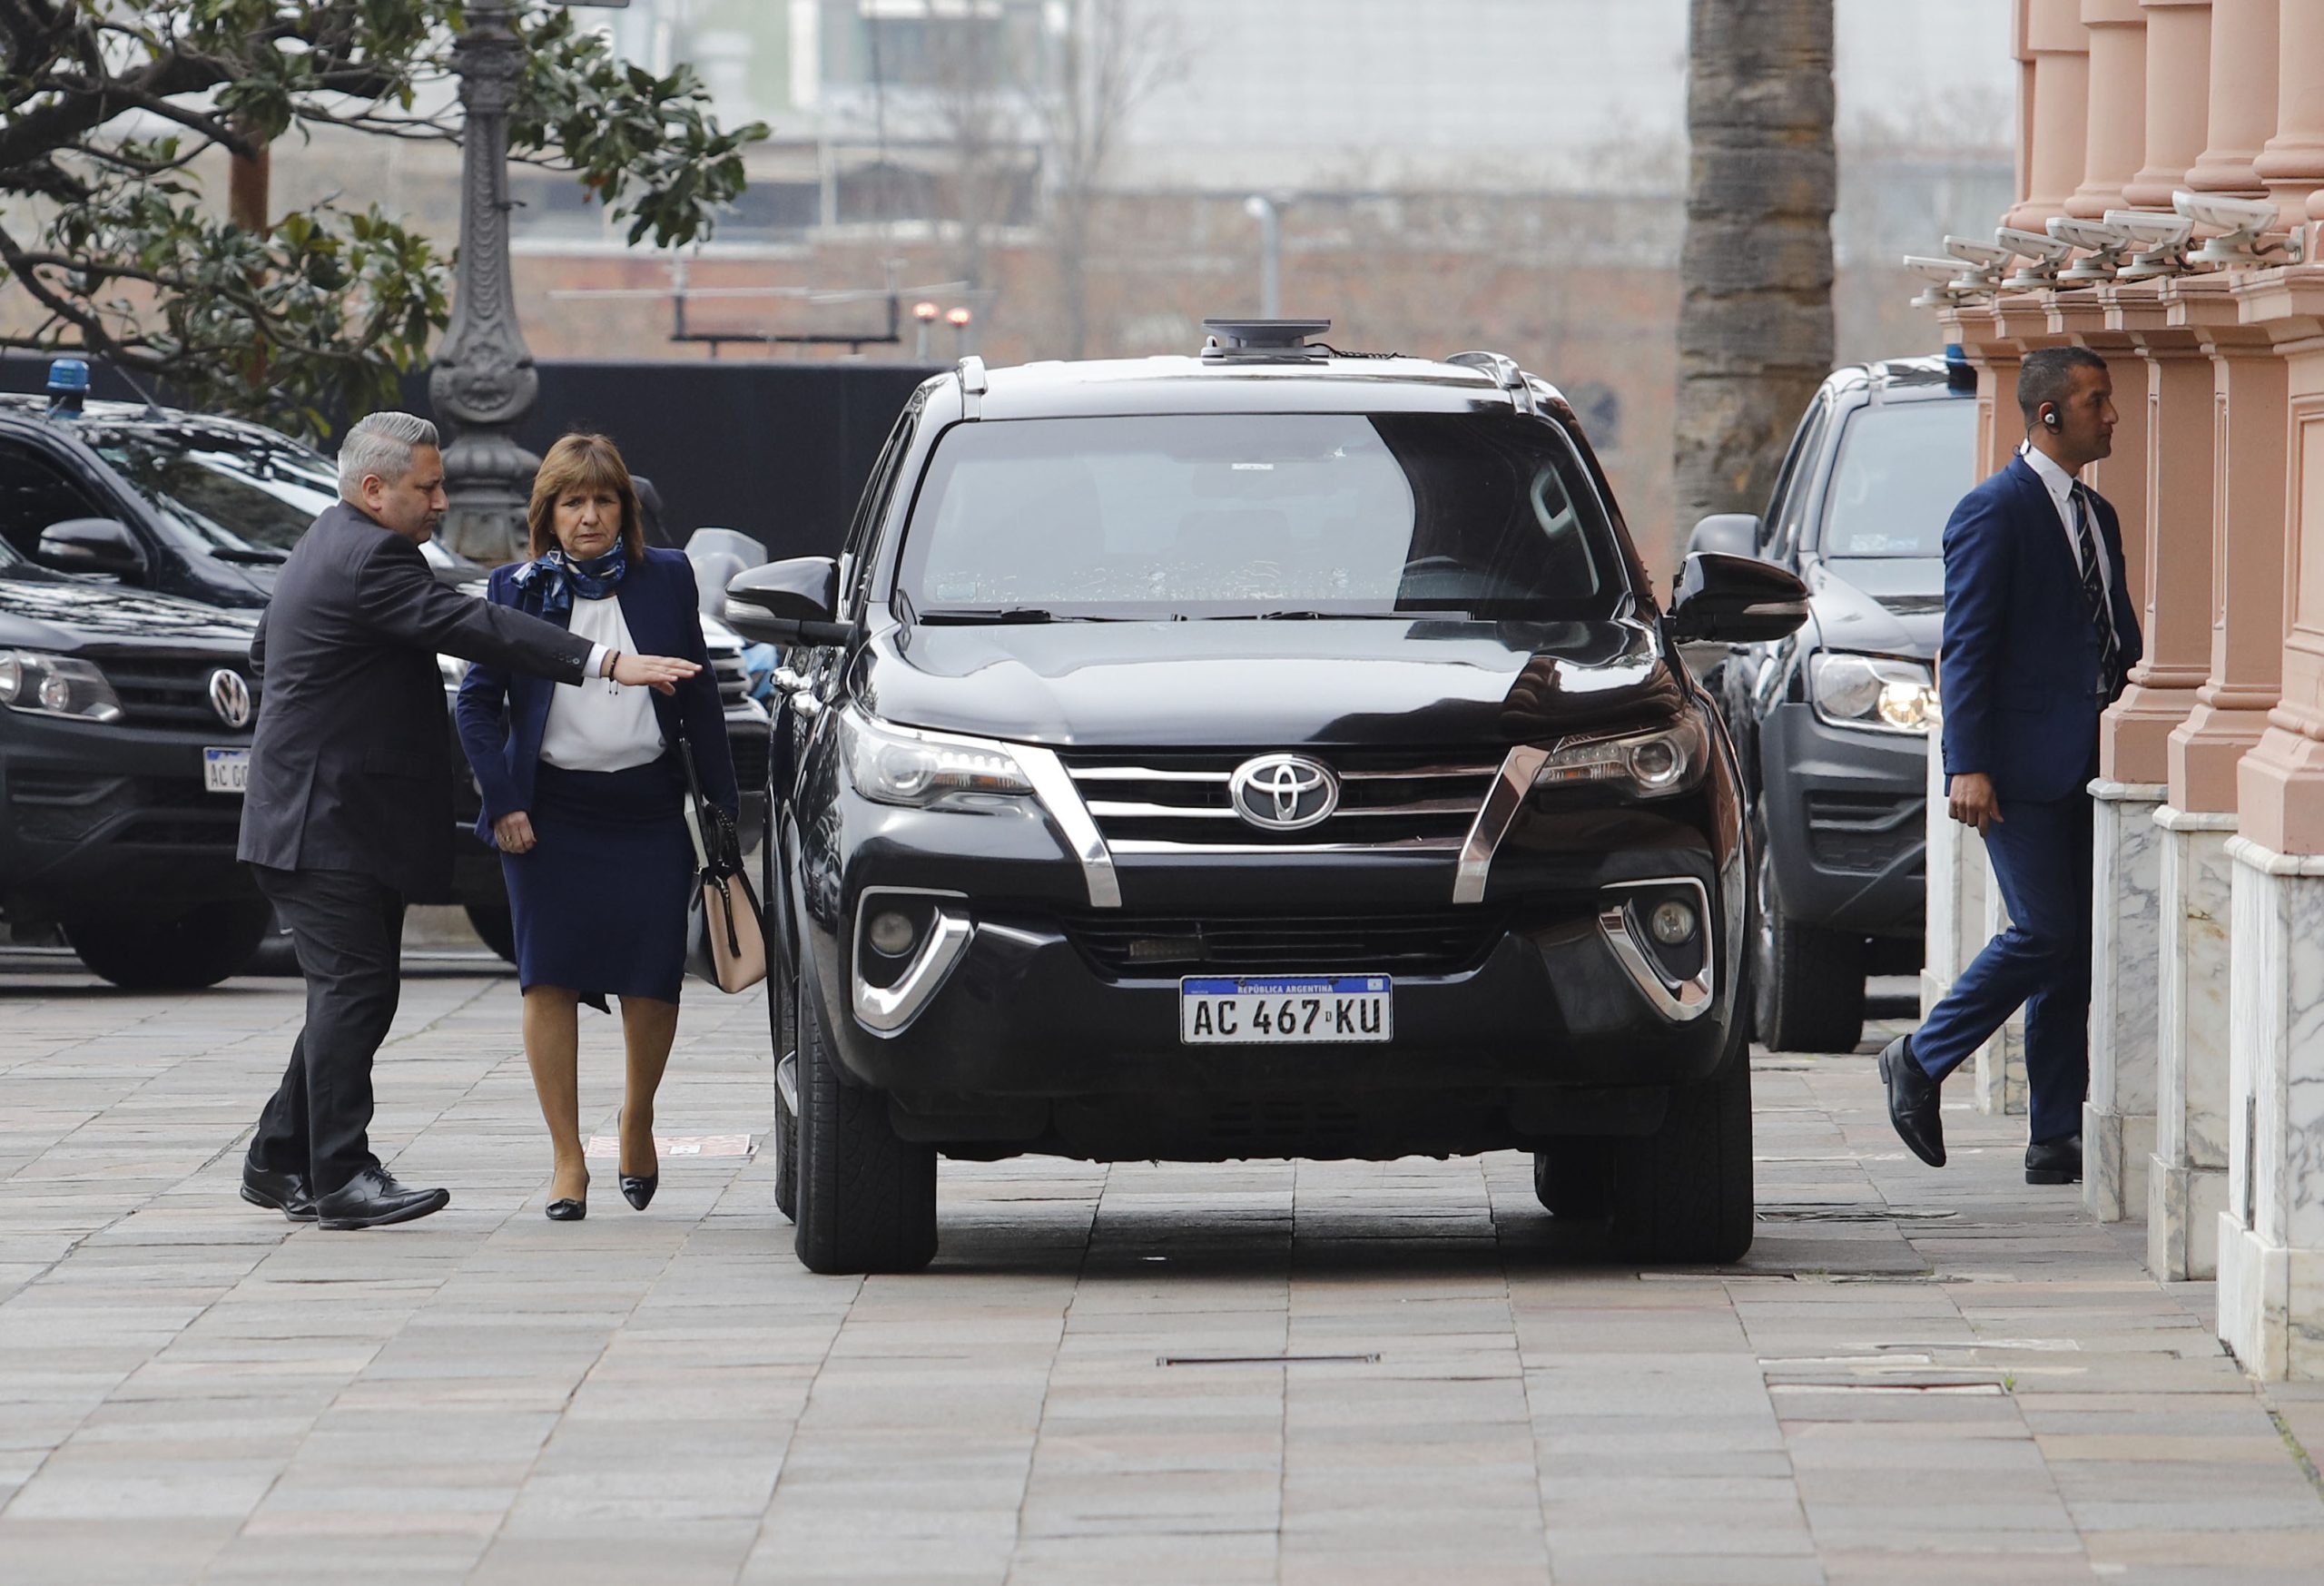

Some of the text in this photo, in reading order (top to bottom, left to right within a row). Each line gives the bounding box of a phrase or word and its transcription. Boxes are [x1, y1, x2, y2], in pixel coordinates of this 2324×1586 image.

[1237, 984, 1334, 994] REPÚBLICA ARGENTINA
[1194, 1000, 1237, 1035] AC
[1253, 1000, 1321, 1034] 467
[1336, 999, 1381, 1033] KU
